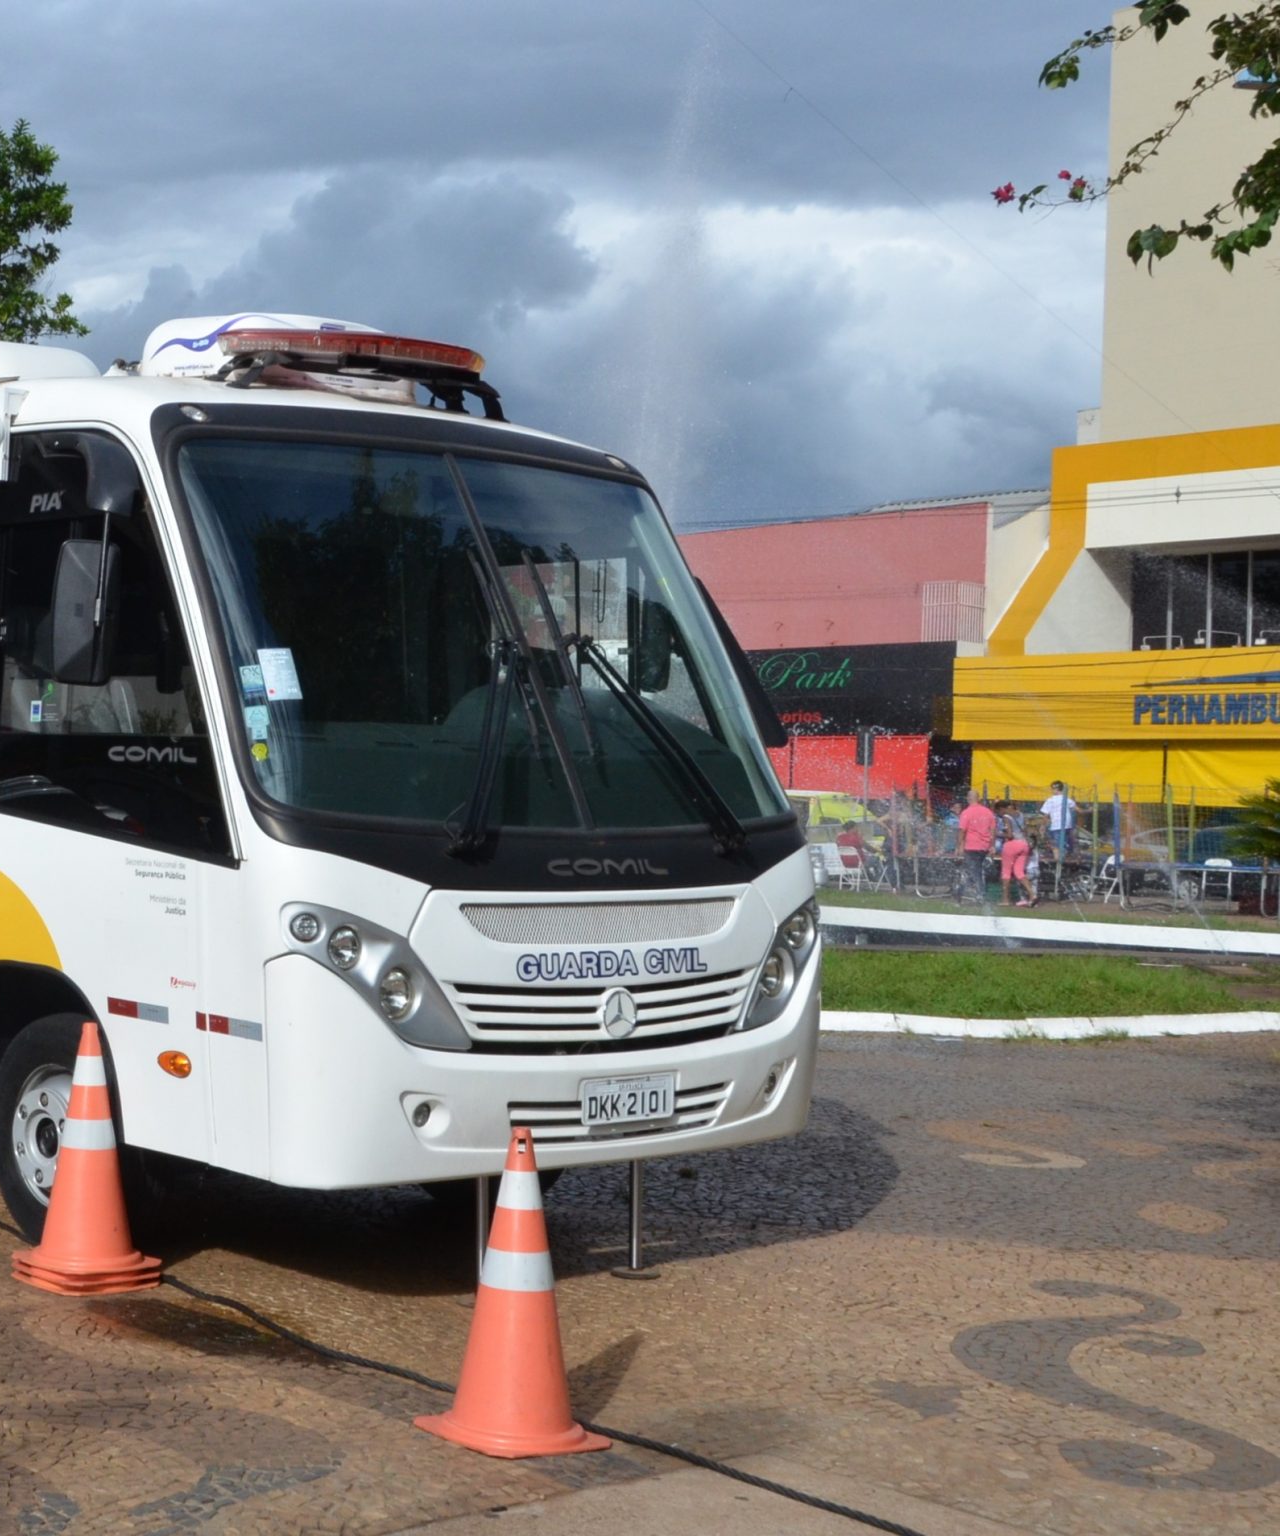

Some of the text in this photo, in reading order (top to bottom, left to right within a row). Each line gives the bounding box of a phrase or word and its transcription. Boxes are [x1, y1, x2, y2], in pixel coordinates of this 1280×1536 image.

[758, 652, 852, 691] Park
[778, 711, 822, 723] orios
[107, 745, 197, 763] COMIL
[135, 868, 186, 880] Segurança Pública
[547, 858, 669, 876] COMIL
[164, 906, 186, 916] Justiça
[516, 948, 707, 982] GUARDA CIVIL
